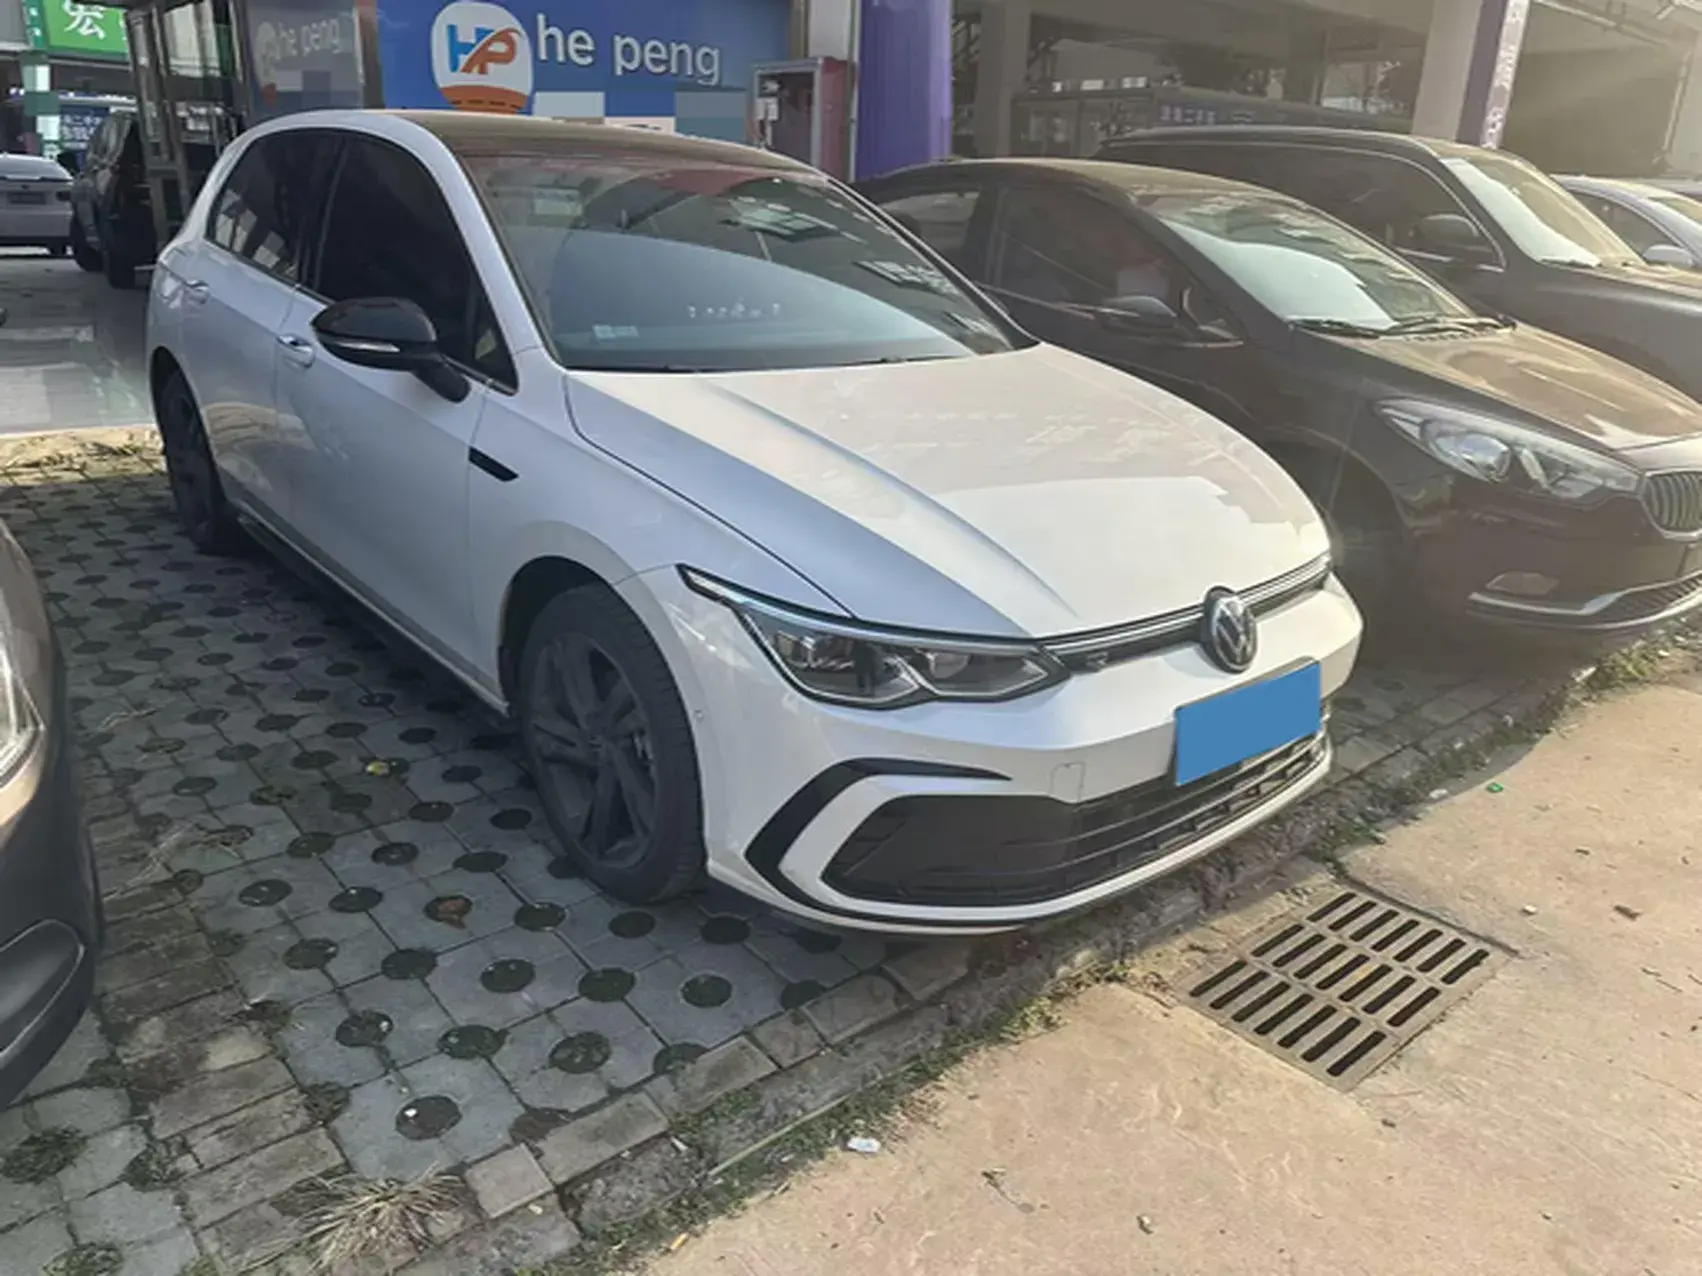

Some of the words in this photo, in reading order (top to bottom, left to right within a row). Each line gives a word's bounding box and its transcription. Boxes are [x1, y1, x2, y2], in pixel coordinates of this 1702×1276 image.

[62, 0, 126, 40] 宏
[537, 13, 595, 65] he
[613, 33, 720, 86] peng
